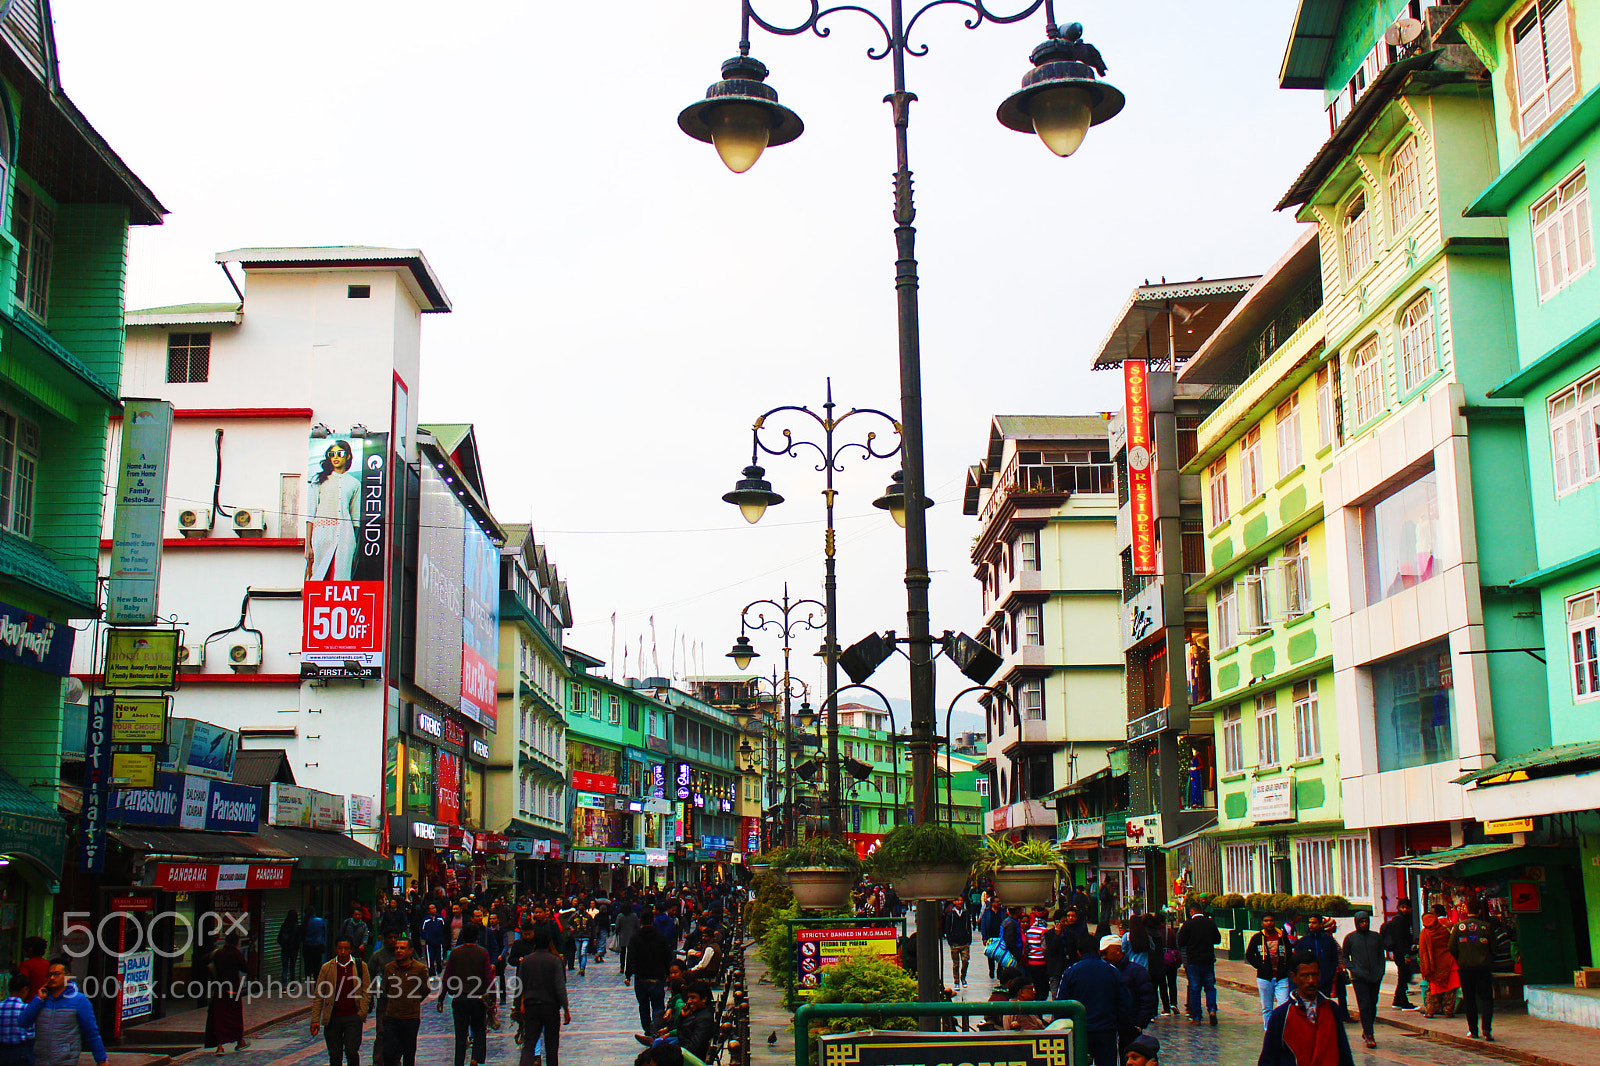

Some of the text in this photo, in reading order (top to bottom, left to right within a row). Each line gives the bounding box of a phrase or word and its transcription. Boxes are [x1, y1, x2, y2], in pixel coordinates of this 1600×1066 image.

[1129, 366, 1146, 443] SOUVENIR
[143, 463, 158, 471] Away
[136, 479, 144, 487] &
[129, 488, 151, 496] Family
[364, 471, 383, 556] TRENDS
[1134, 473, 1151, 563] RESIDENCY
[131, 557, 149, 565] Family
[325, 585, 360, 601] FLAT
[319, 668, 342, 676] FIRST
[465, 660, 477, 697] FLAT
[115, 704, 138, 712] New
[424, 714, 441, 738] TRENDS
[211, 791, 256, 823] Panasonic
[168, 867, 207, 882] PANORAMA
[126, 957, 151, 971] BAJAJ
[126, 969, 150, 983] FINSERV
